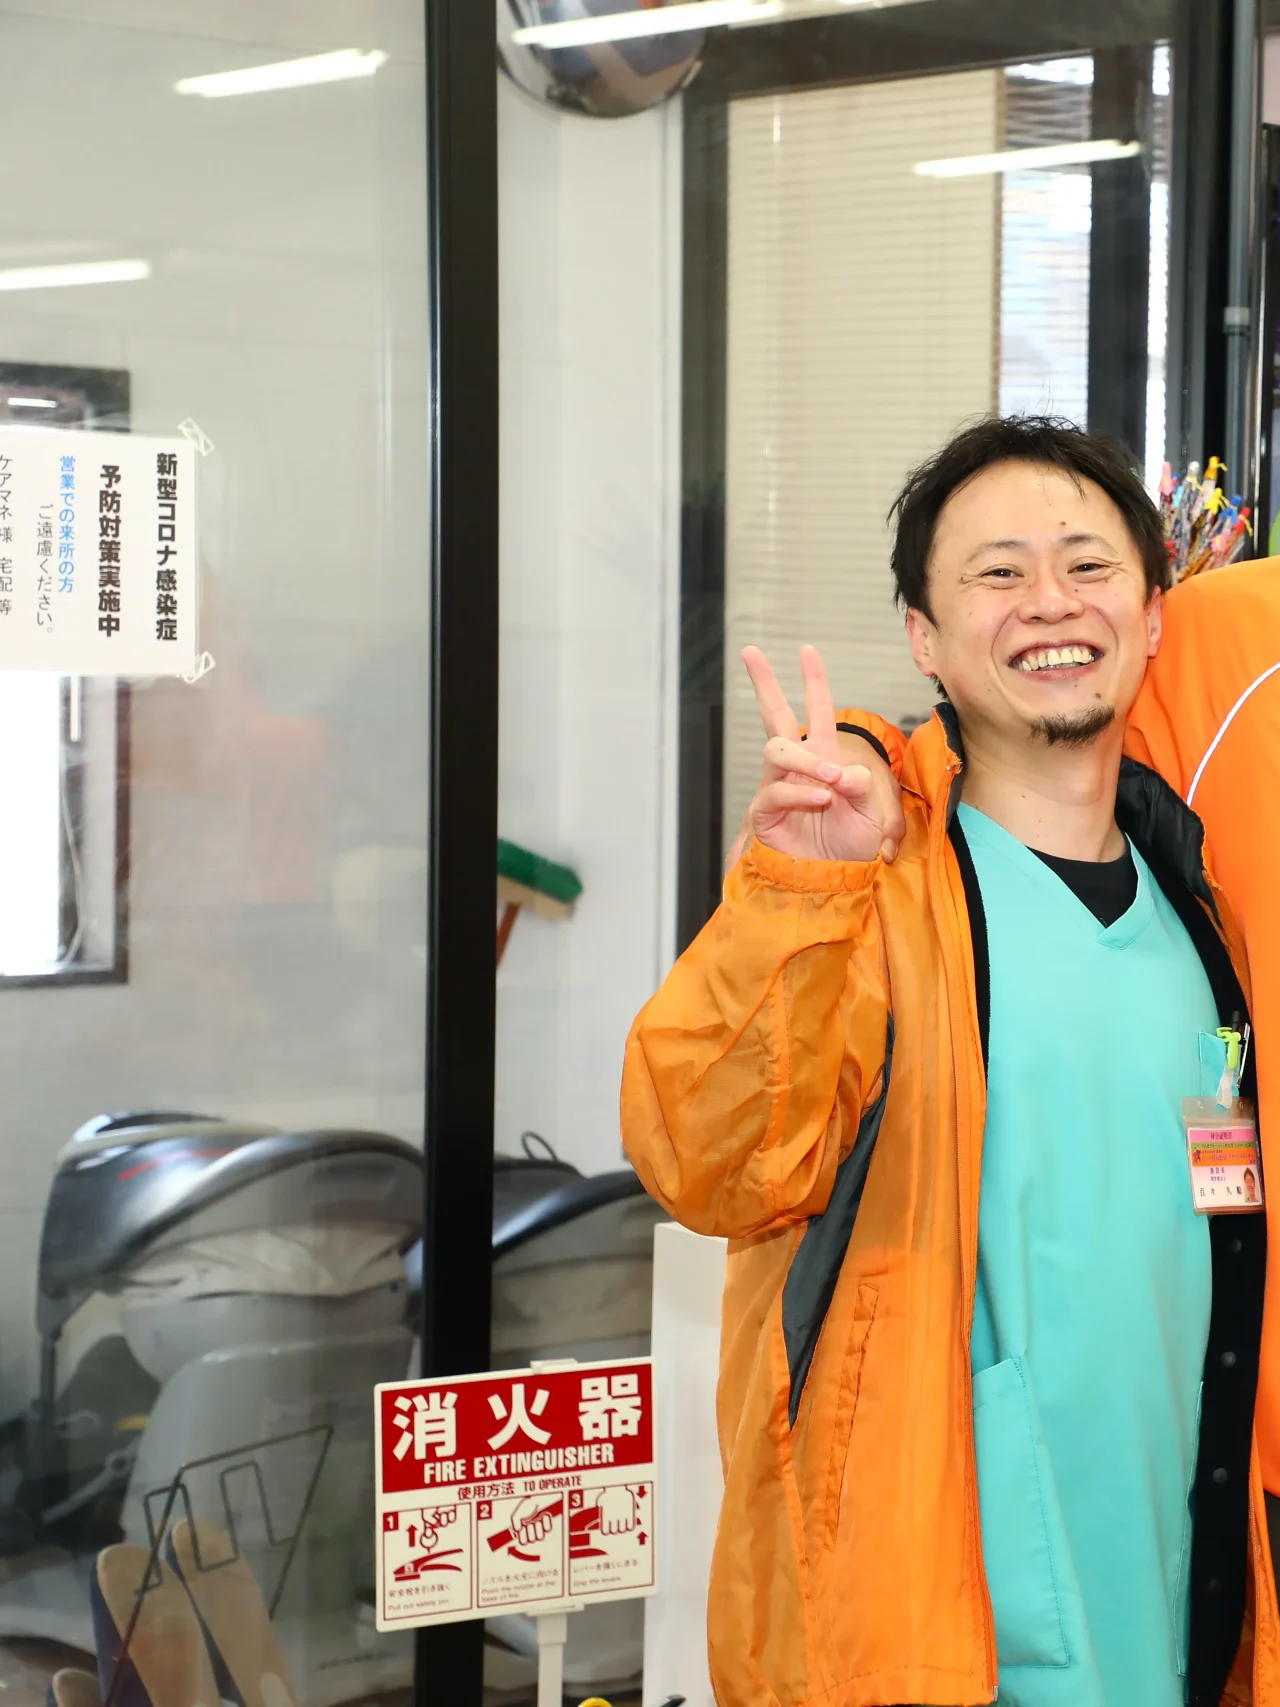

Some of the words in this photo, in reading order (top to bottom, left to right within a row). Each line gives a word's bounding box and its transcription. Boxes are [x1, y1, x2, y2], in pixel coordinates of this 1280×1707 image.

[0, 454, 13, 520] ケアマネ
[58, 455, 76, 594] 営業での来所の方
[98, 464, 122, 637] 予防対策実施中
[156, 452, 178, 641] 新型コロナ感染症
[0, 556, 13, 592] 宅配
[36, 503, 54, 634] ご遠慮ください。
[392, 1374, 643, 1461] 消火器
[423, 1459, 467, 1484] FIRE
[473, 1443, 615, 1479] EXTINGUISHER
[457, 1481, 515, 1501] 使用方法
[523, 1480, 538, 1492] TO
[539, 1475, 582, 1491] OPERATE
[387, 1515, 394, 1529] 1
[480, 1504, 490, 1518] 2
[571, 1493, 580, 1507] 3
